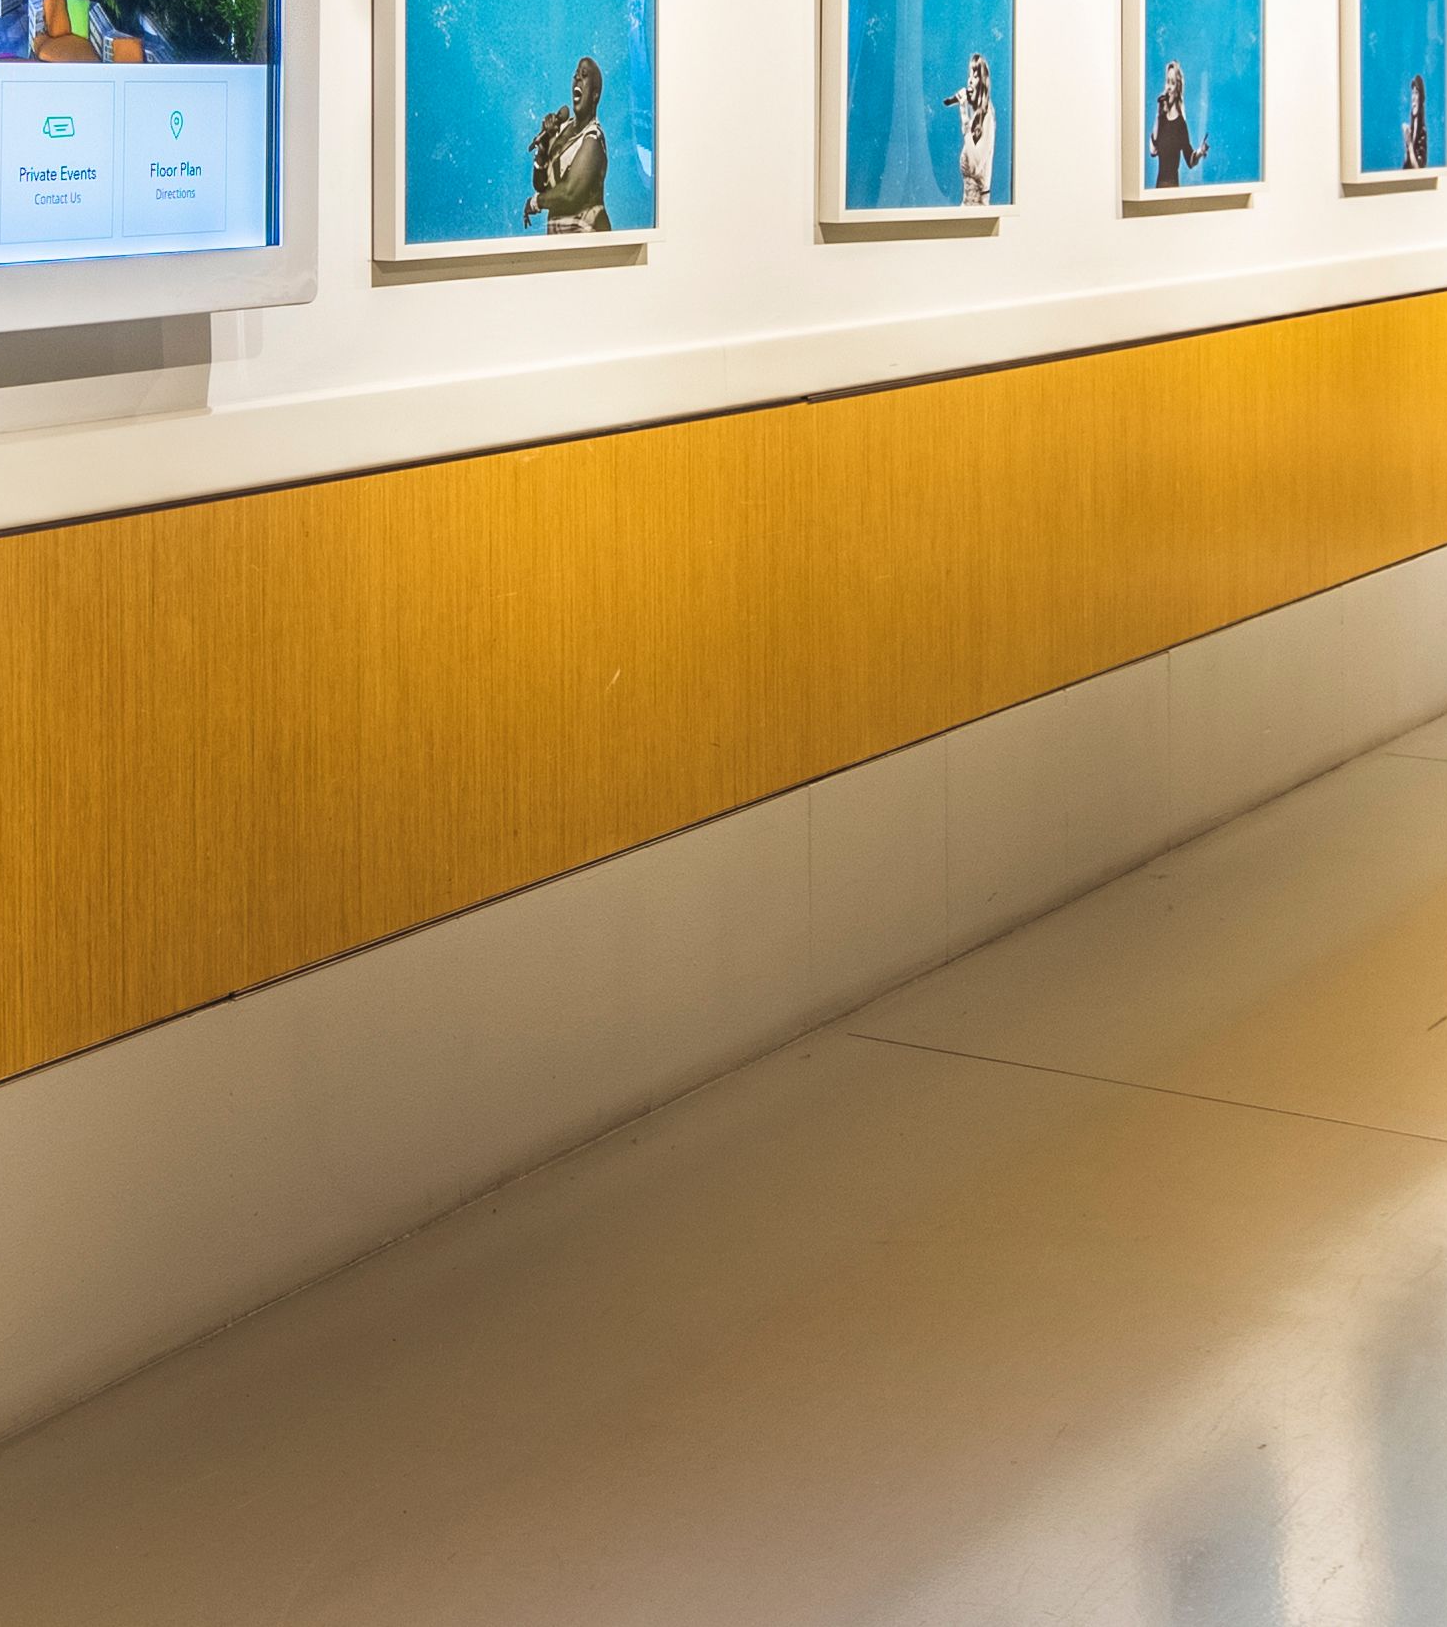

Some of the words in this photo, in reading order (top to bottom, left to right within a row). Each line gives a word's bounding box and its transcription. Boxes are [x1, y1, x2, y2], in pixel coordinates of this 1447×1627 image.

[19, 166, 57, 183] Private
[61, 165, 97, 181] Events
[150, 163, 177, 179] Floor
[180, 162, 201, 178] Plan
[34, 193, 67, 206] Contact
[70, 191, 81, 204] Us
[156, 187, 195, 200] Directions
